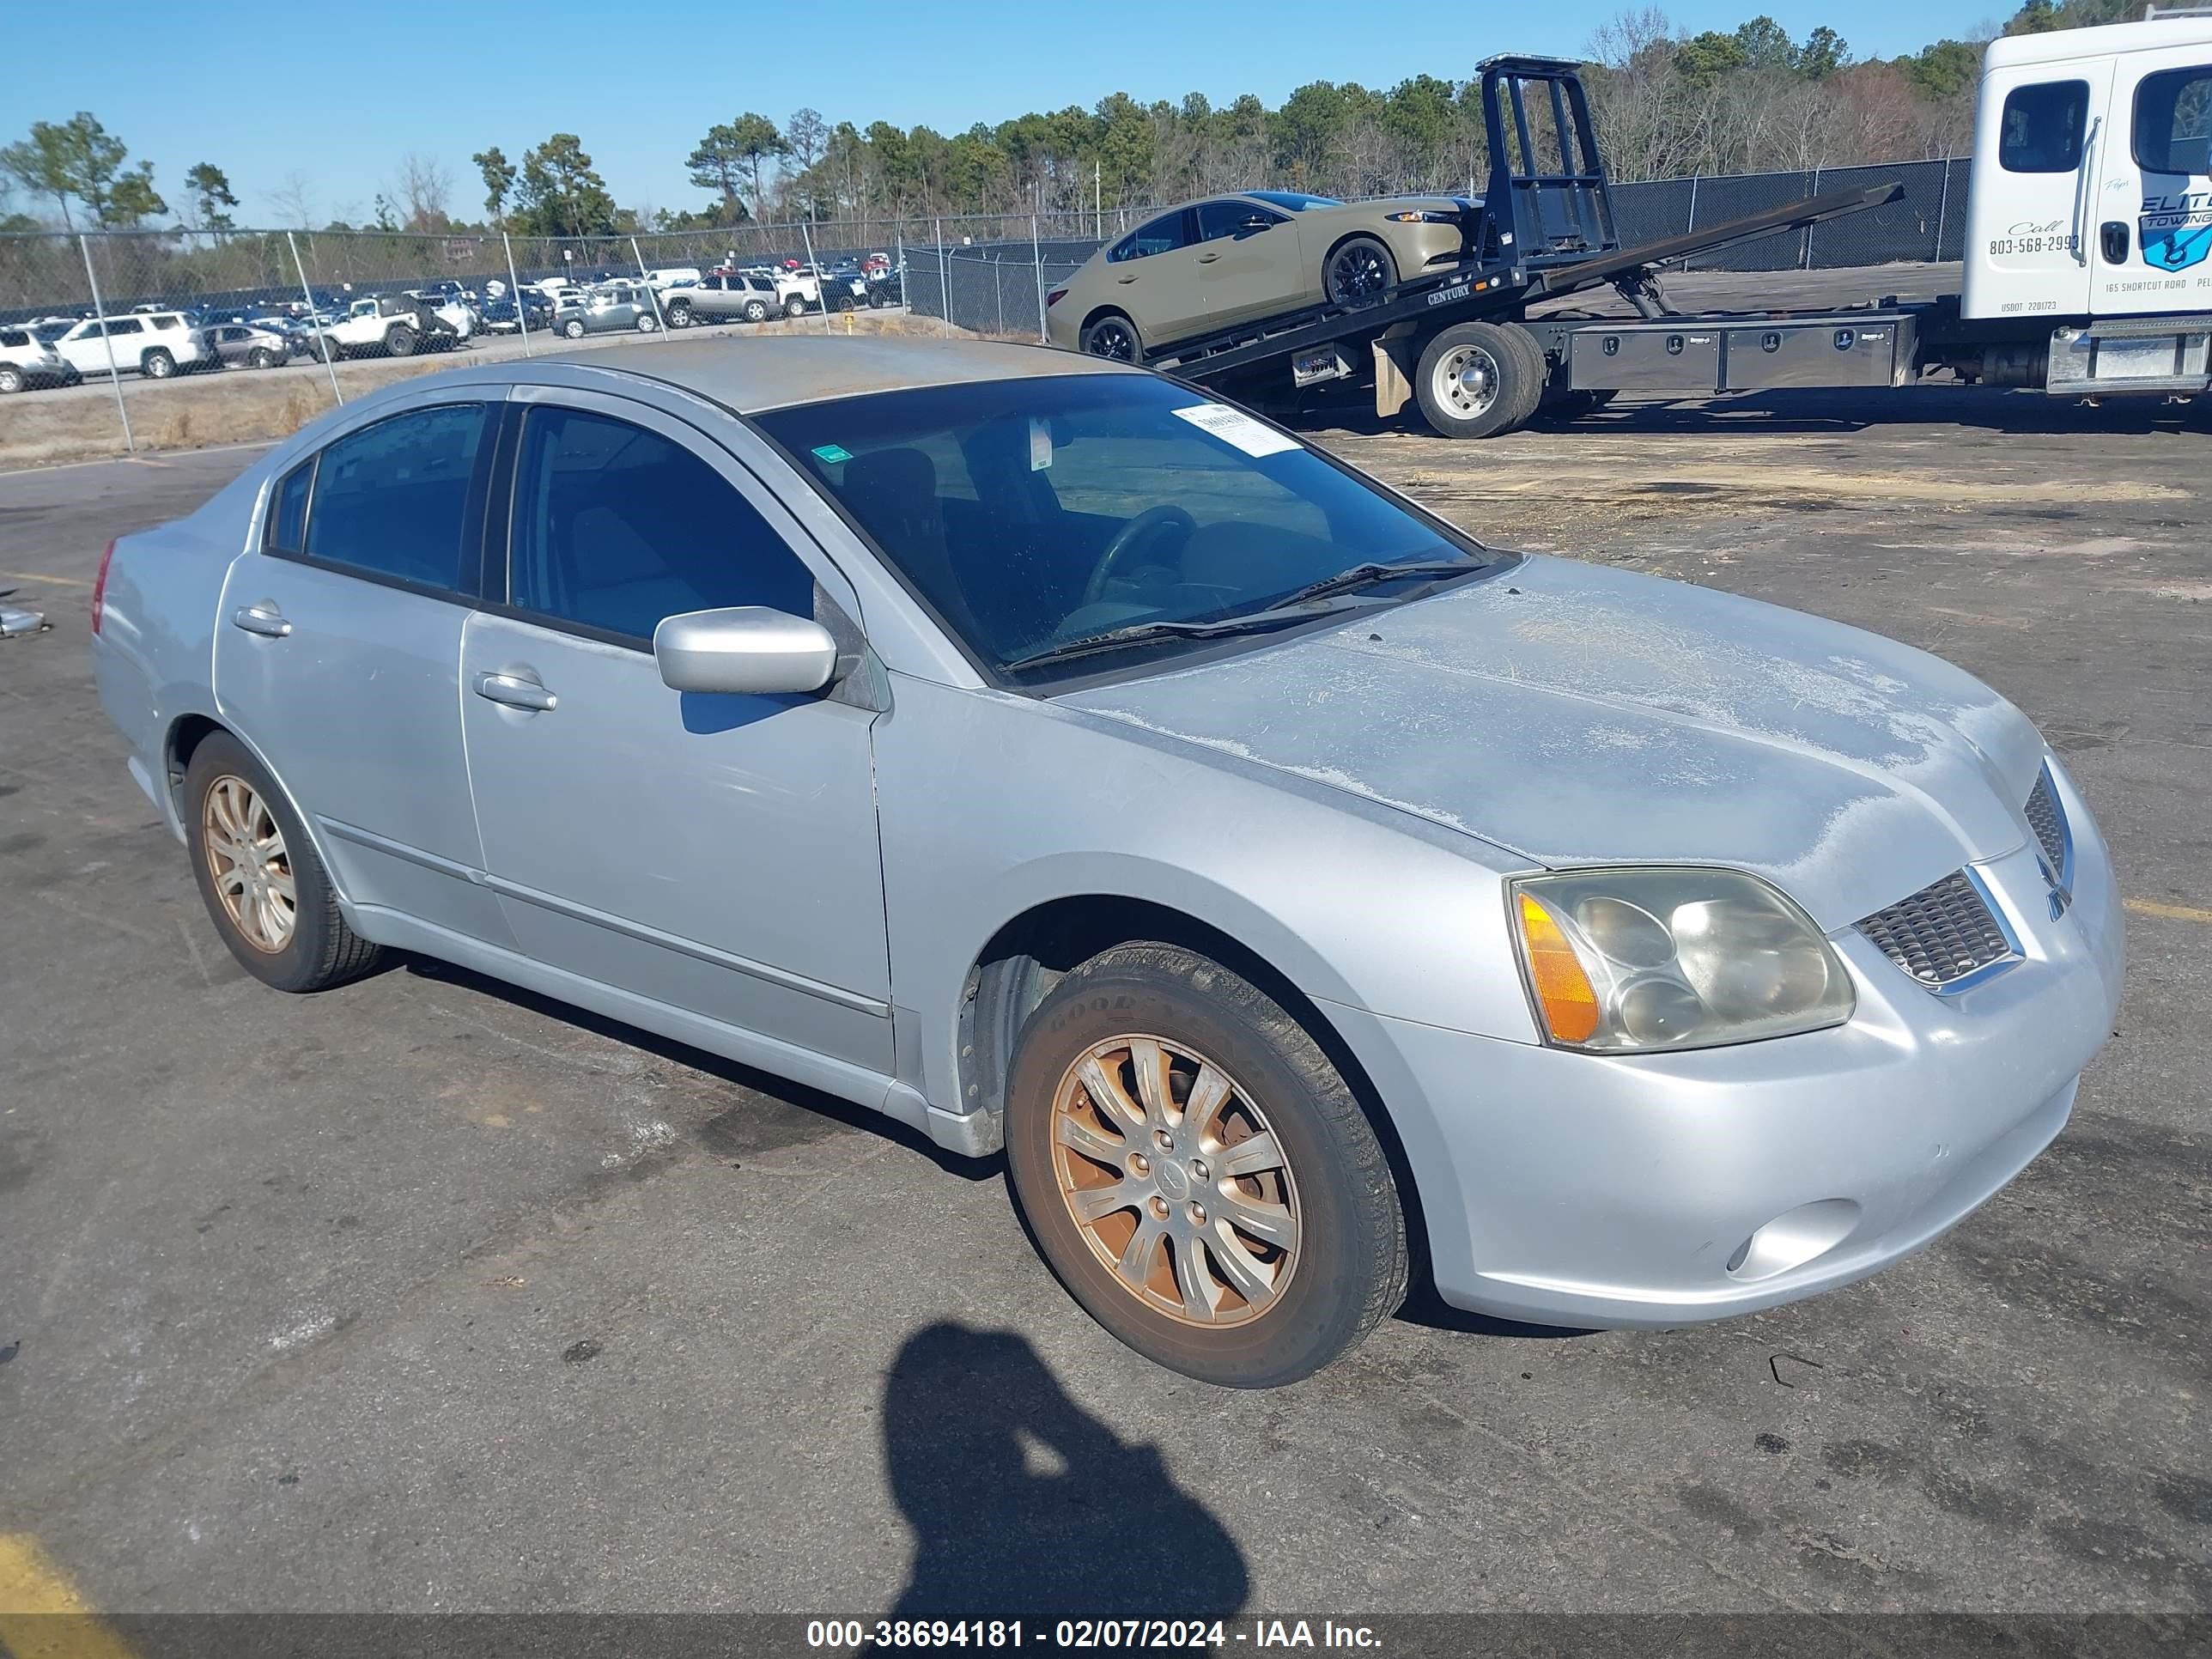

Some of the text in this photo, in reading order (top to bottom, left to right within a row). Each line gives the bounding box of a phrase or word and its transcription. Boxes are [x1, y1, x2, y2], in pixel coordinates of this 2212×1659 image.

[2008, 220, 2064, 236] Call
[2147, 213, 2212, 228] TOWING
[1990, 234, 2079, 255] 803-568-2993
[2106, 277, 2212, 293] 165 SHORTCUT ROAD PEL
[1428, 284, 1469, 305] CENTURY
[2001, 301, 2057, 313] USDOT 2201723
